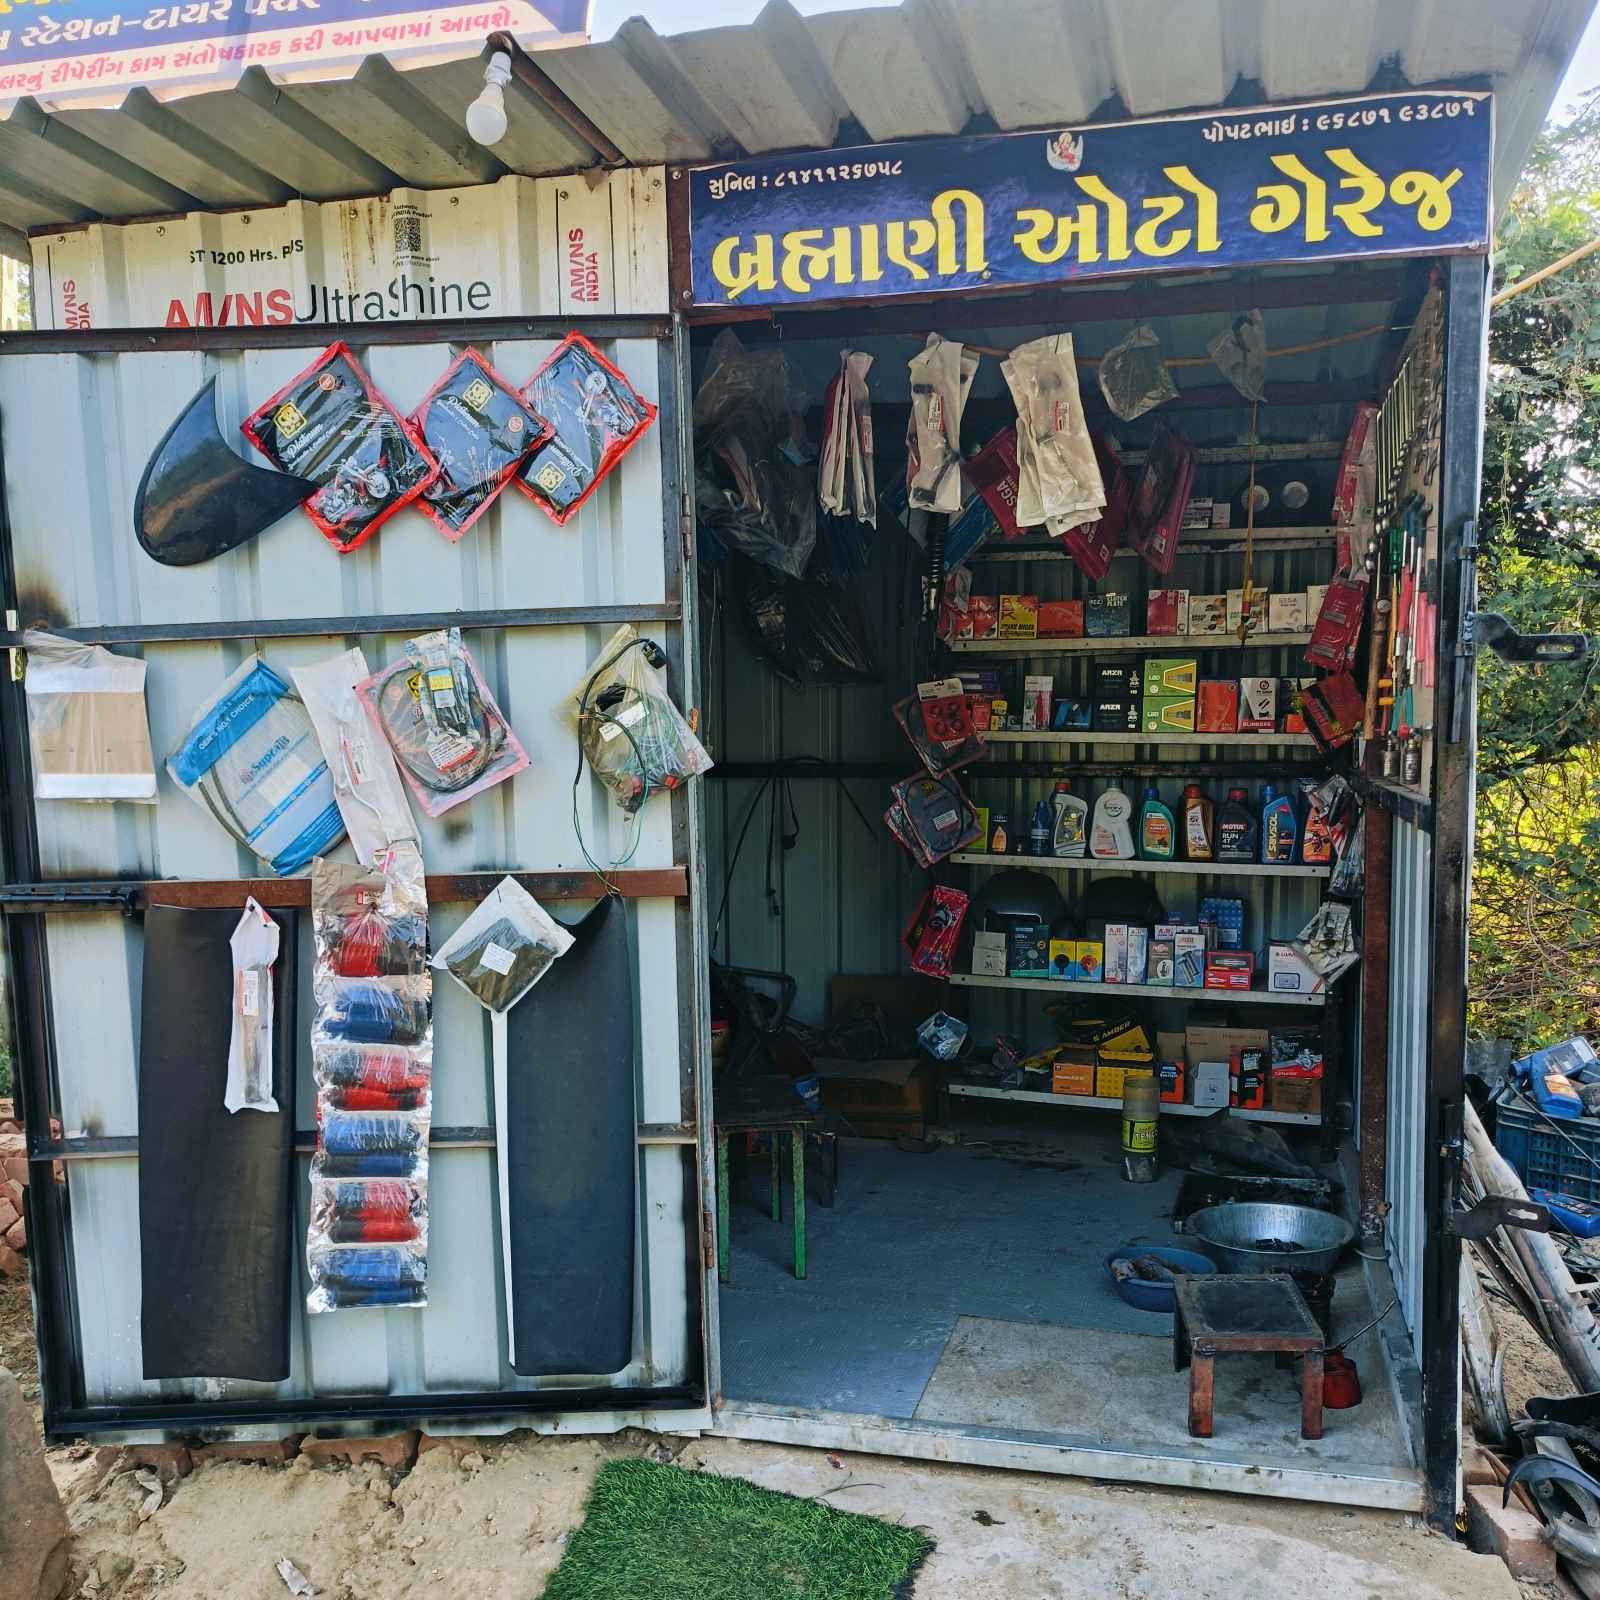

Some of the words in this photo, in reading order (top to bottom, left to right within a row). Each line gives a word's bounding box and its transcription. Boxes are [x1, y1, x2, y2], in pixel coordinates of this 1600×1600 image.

[129, 51, 166, 74] કામ
[173, 40, 282, 68] સંતોષકારક
[288, 29, 324, 54] કરી
[331, 15, 432, 47] આપવામાં
[708, 172, 756, 199] સુનિલ
[711, 188, 987, 302] બ્રહ્માણી
[1013, 165, 1220, 266] ઓટો
[1249, 147, 1464, 244] ગેરેજ
[210, 249, 246, 265] 1200
[250, 248, 278, 262] Hrs.
[569, 227, 585, 302] AM/NS
[585, 250, 599, 302] INDIA
